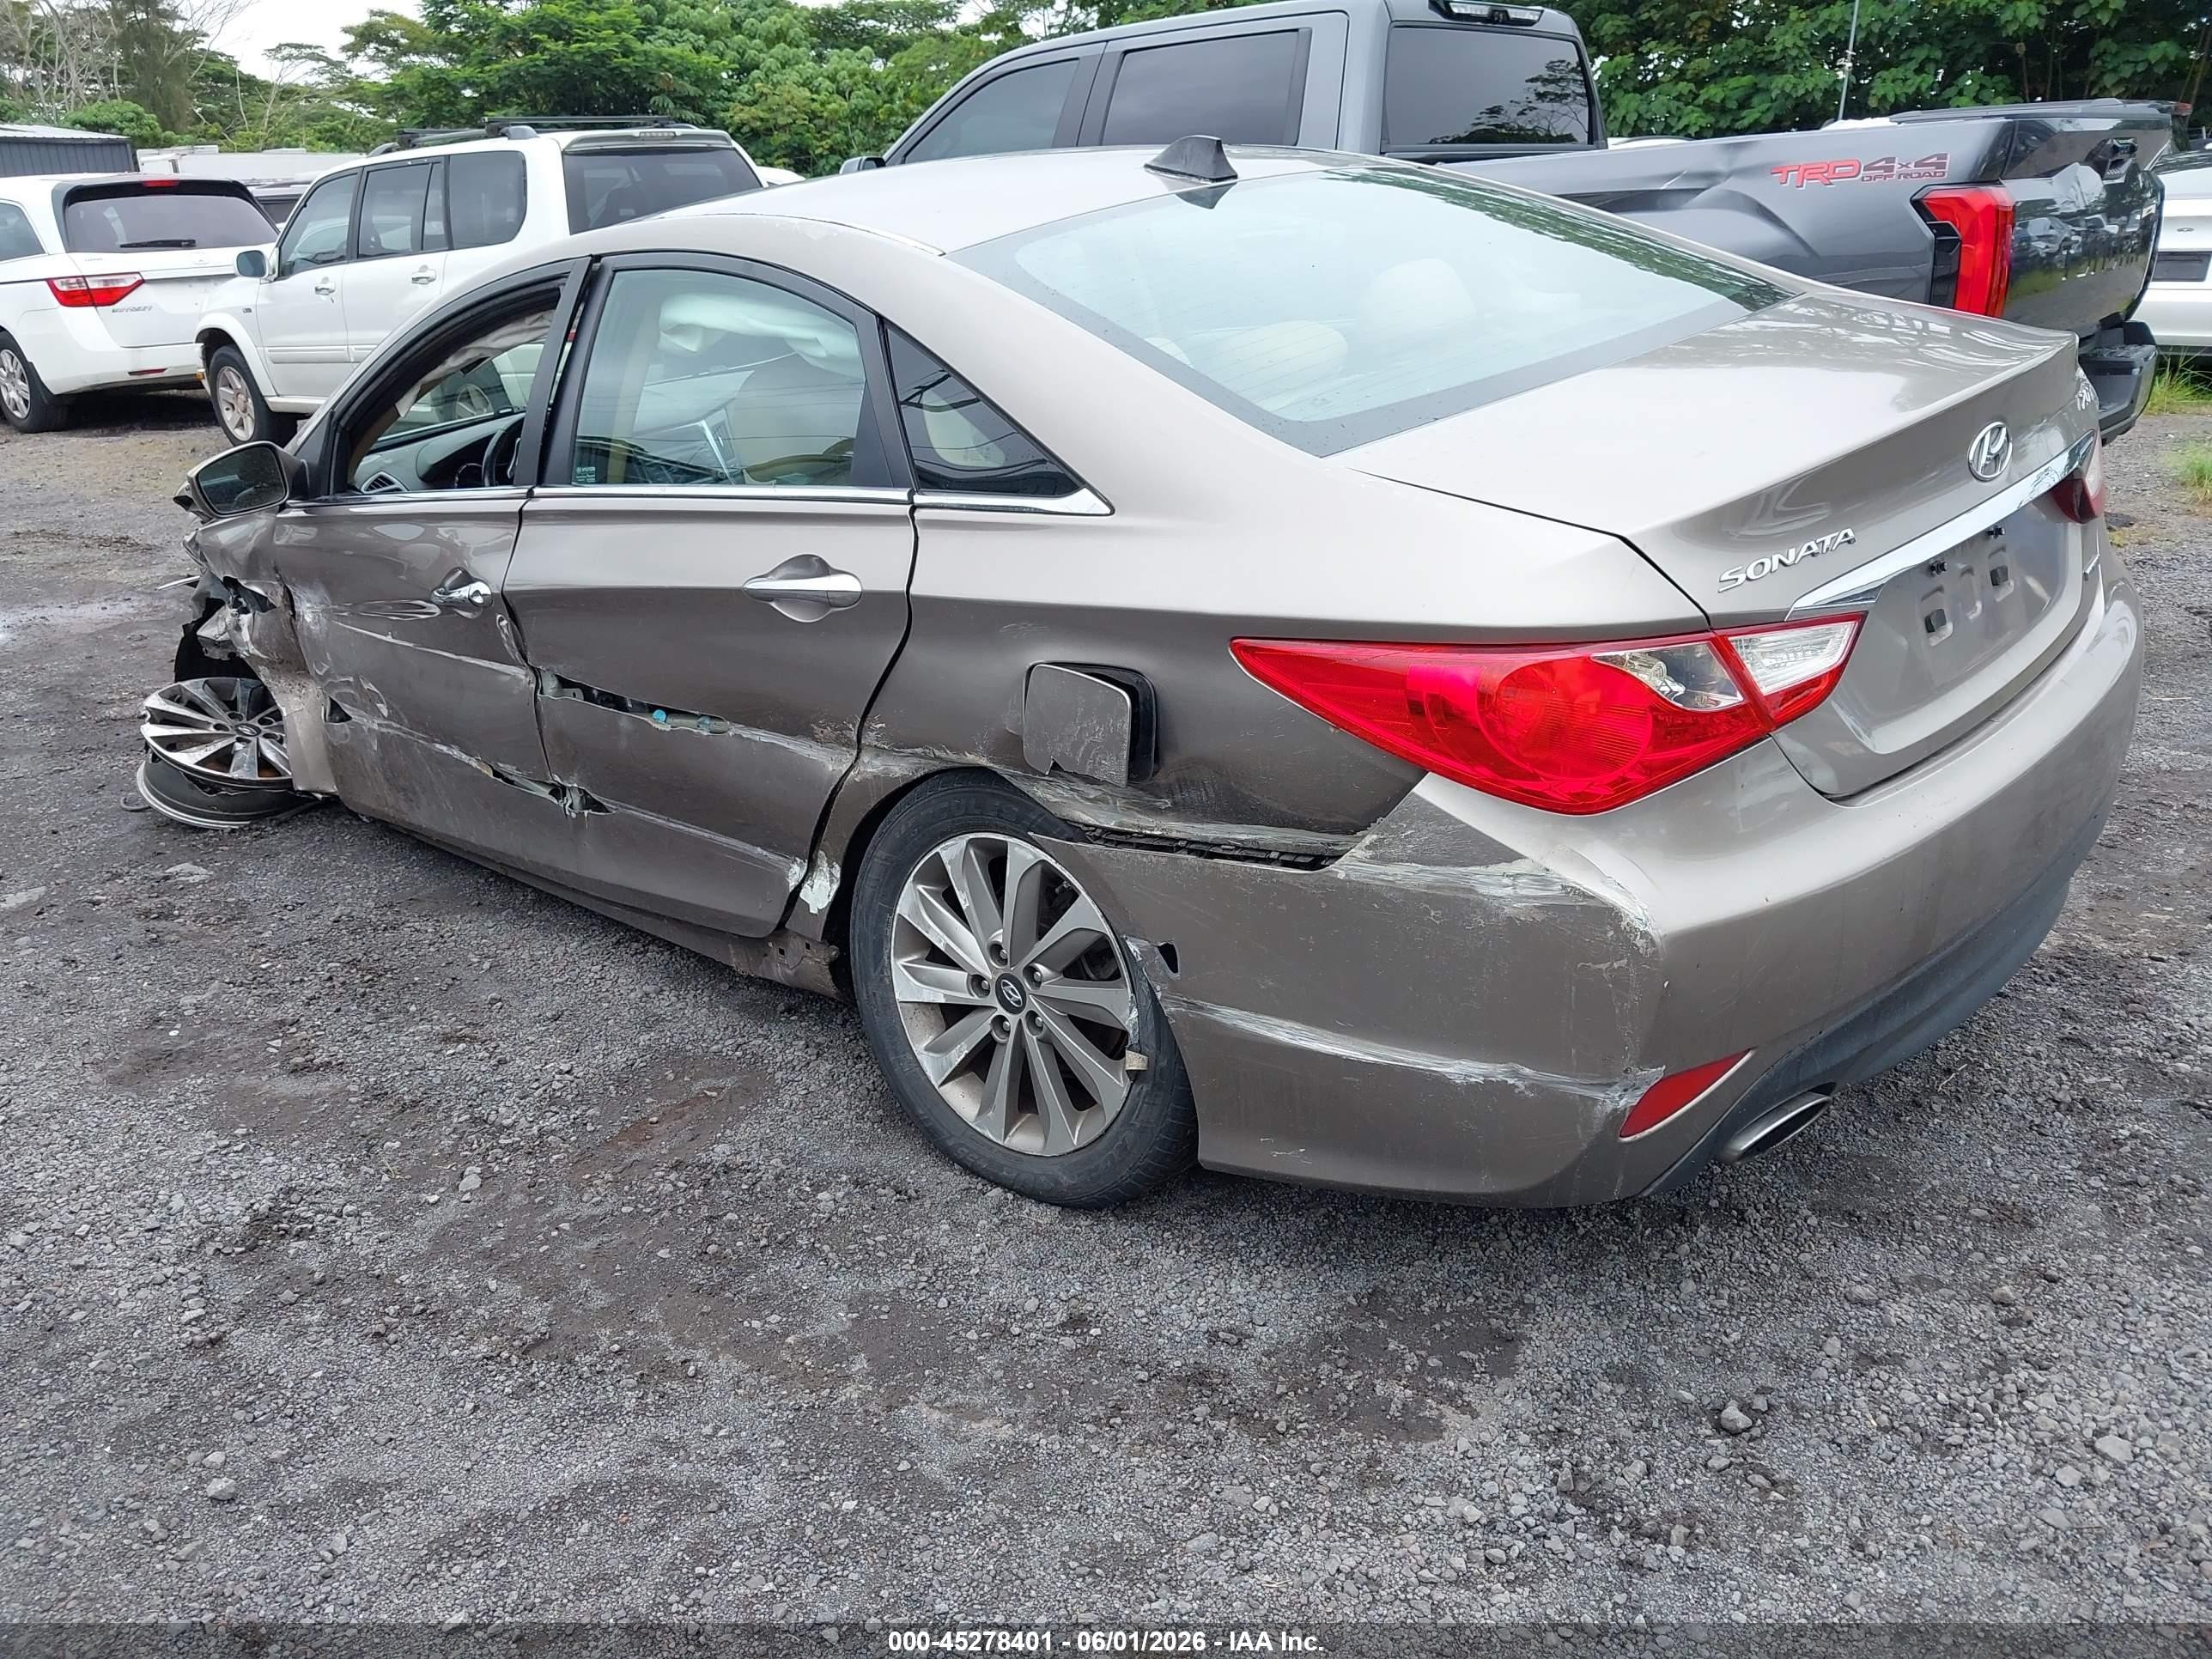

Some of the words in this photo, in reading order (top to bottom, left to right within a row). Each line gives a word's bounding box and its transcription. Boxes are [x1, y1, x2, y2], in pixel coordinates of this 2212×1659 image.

[1771, 159, 1863, 189] TRD
[1862, 152, 1948, 173] 4x4
[1860, 173, 1895, 183] OFF
[1897, 170, 1946, 180] ROAD
[1717, 527, 1856, 593] SONATA
